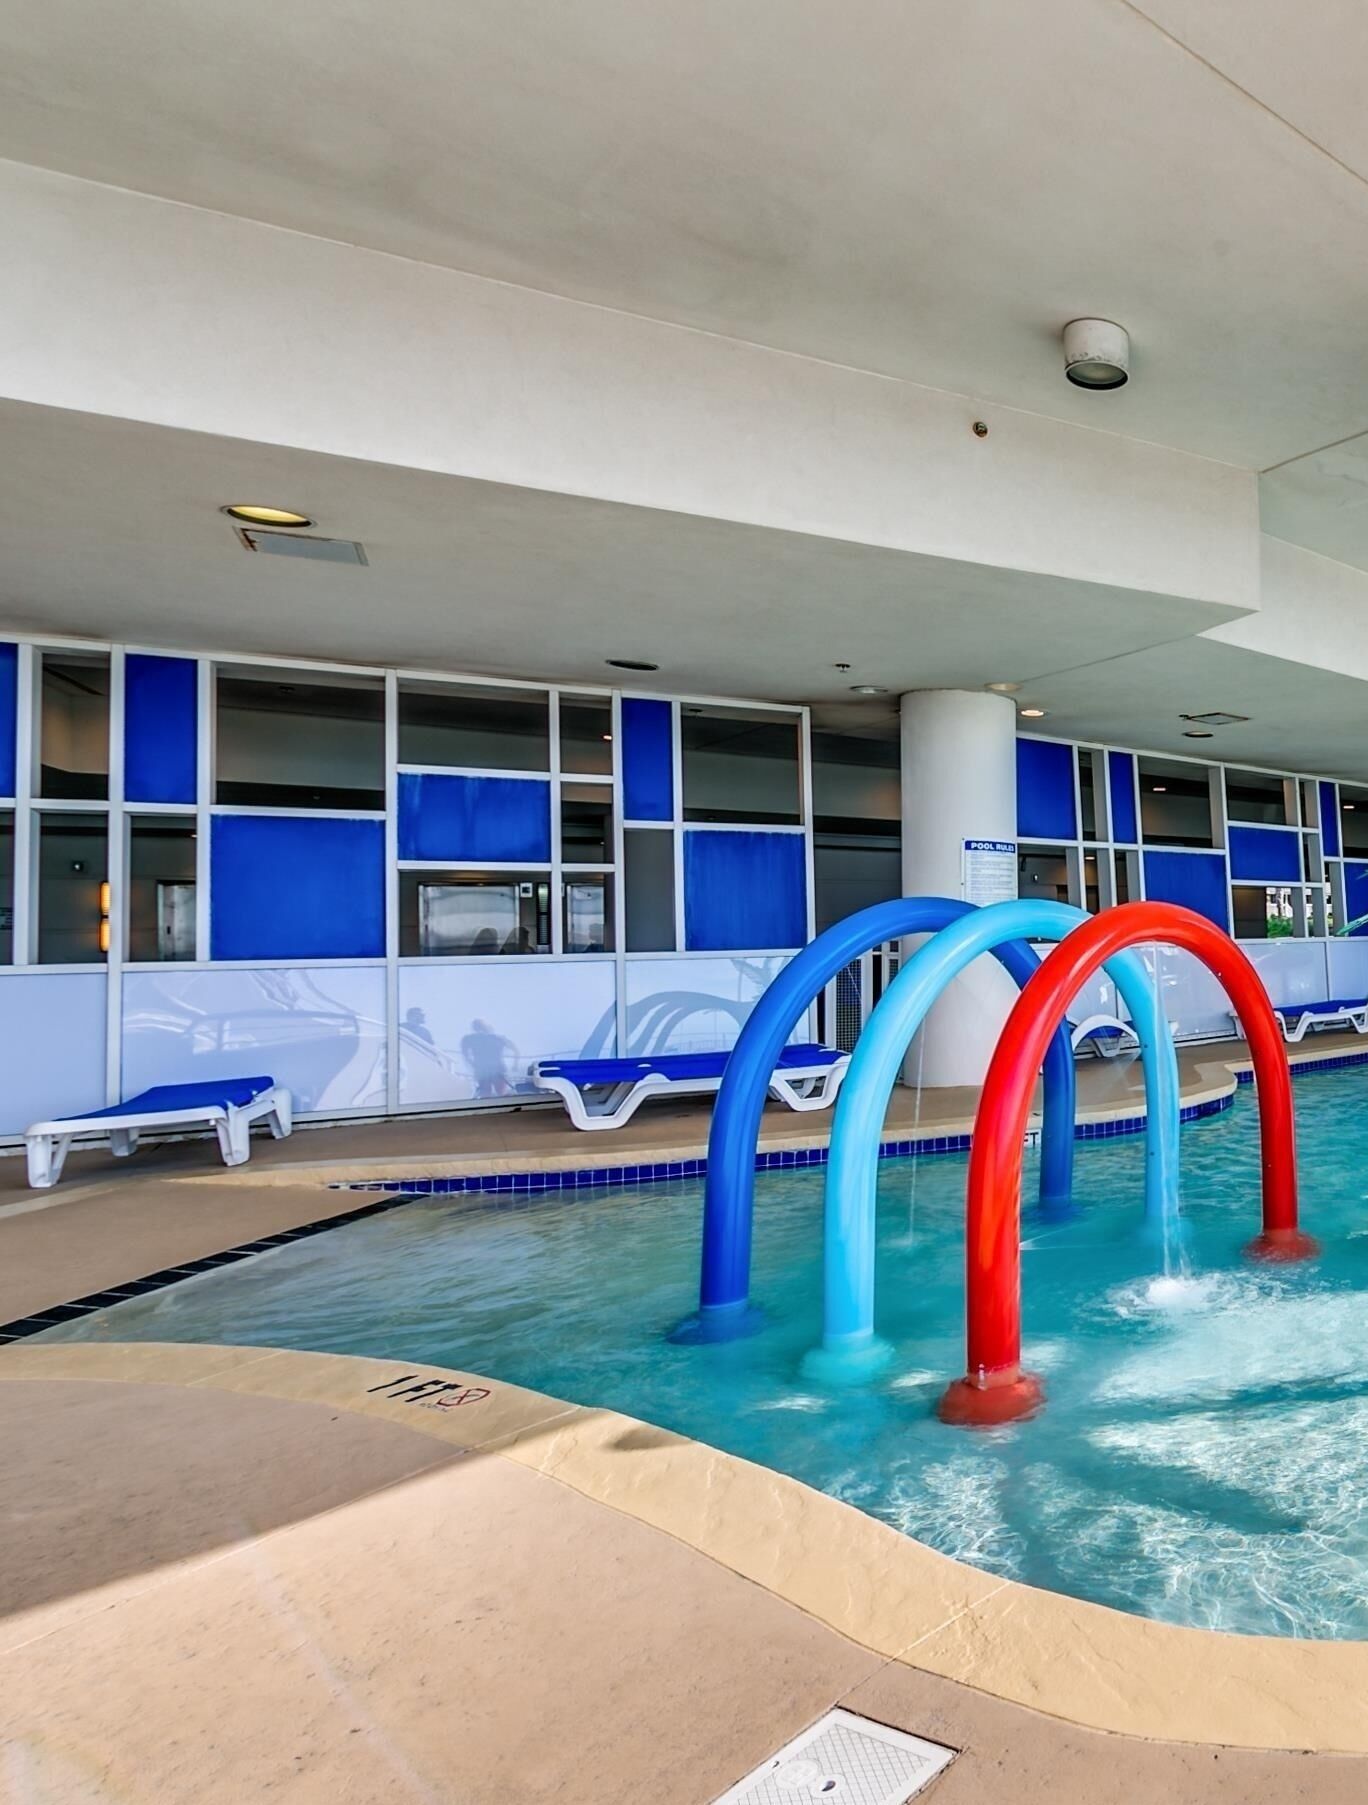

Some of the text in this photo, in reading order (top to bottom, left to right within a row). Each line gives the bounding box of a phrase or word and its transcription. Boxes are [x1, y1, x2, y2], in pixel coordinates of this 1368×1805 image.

[971, 842, 1014, 852] POOL RULES
[366, 1374, 463, 1403] 1 FT
